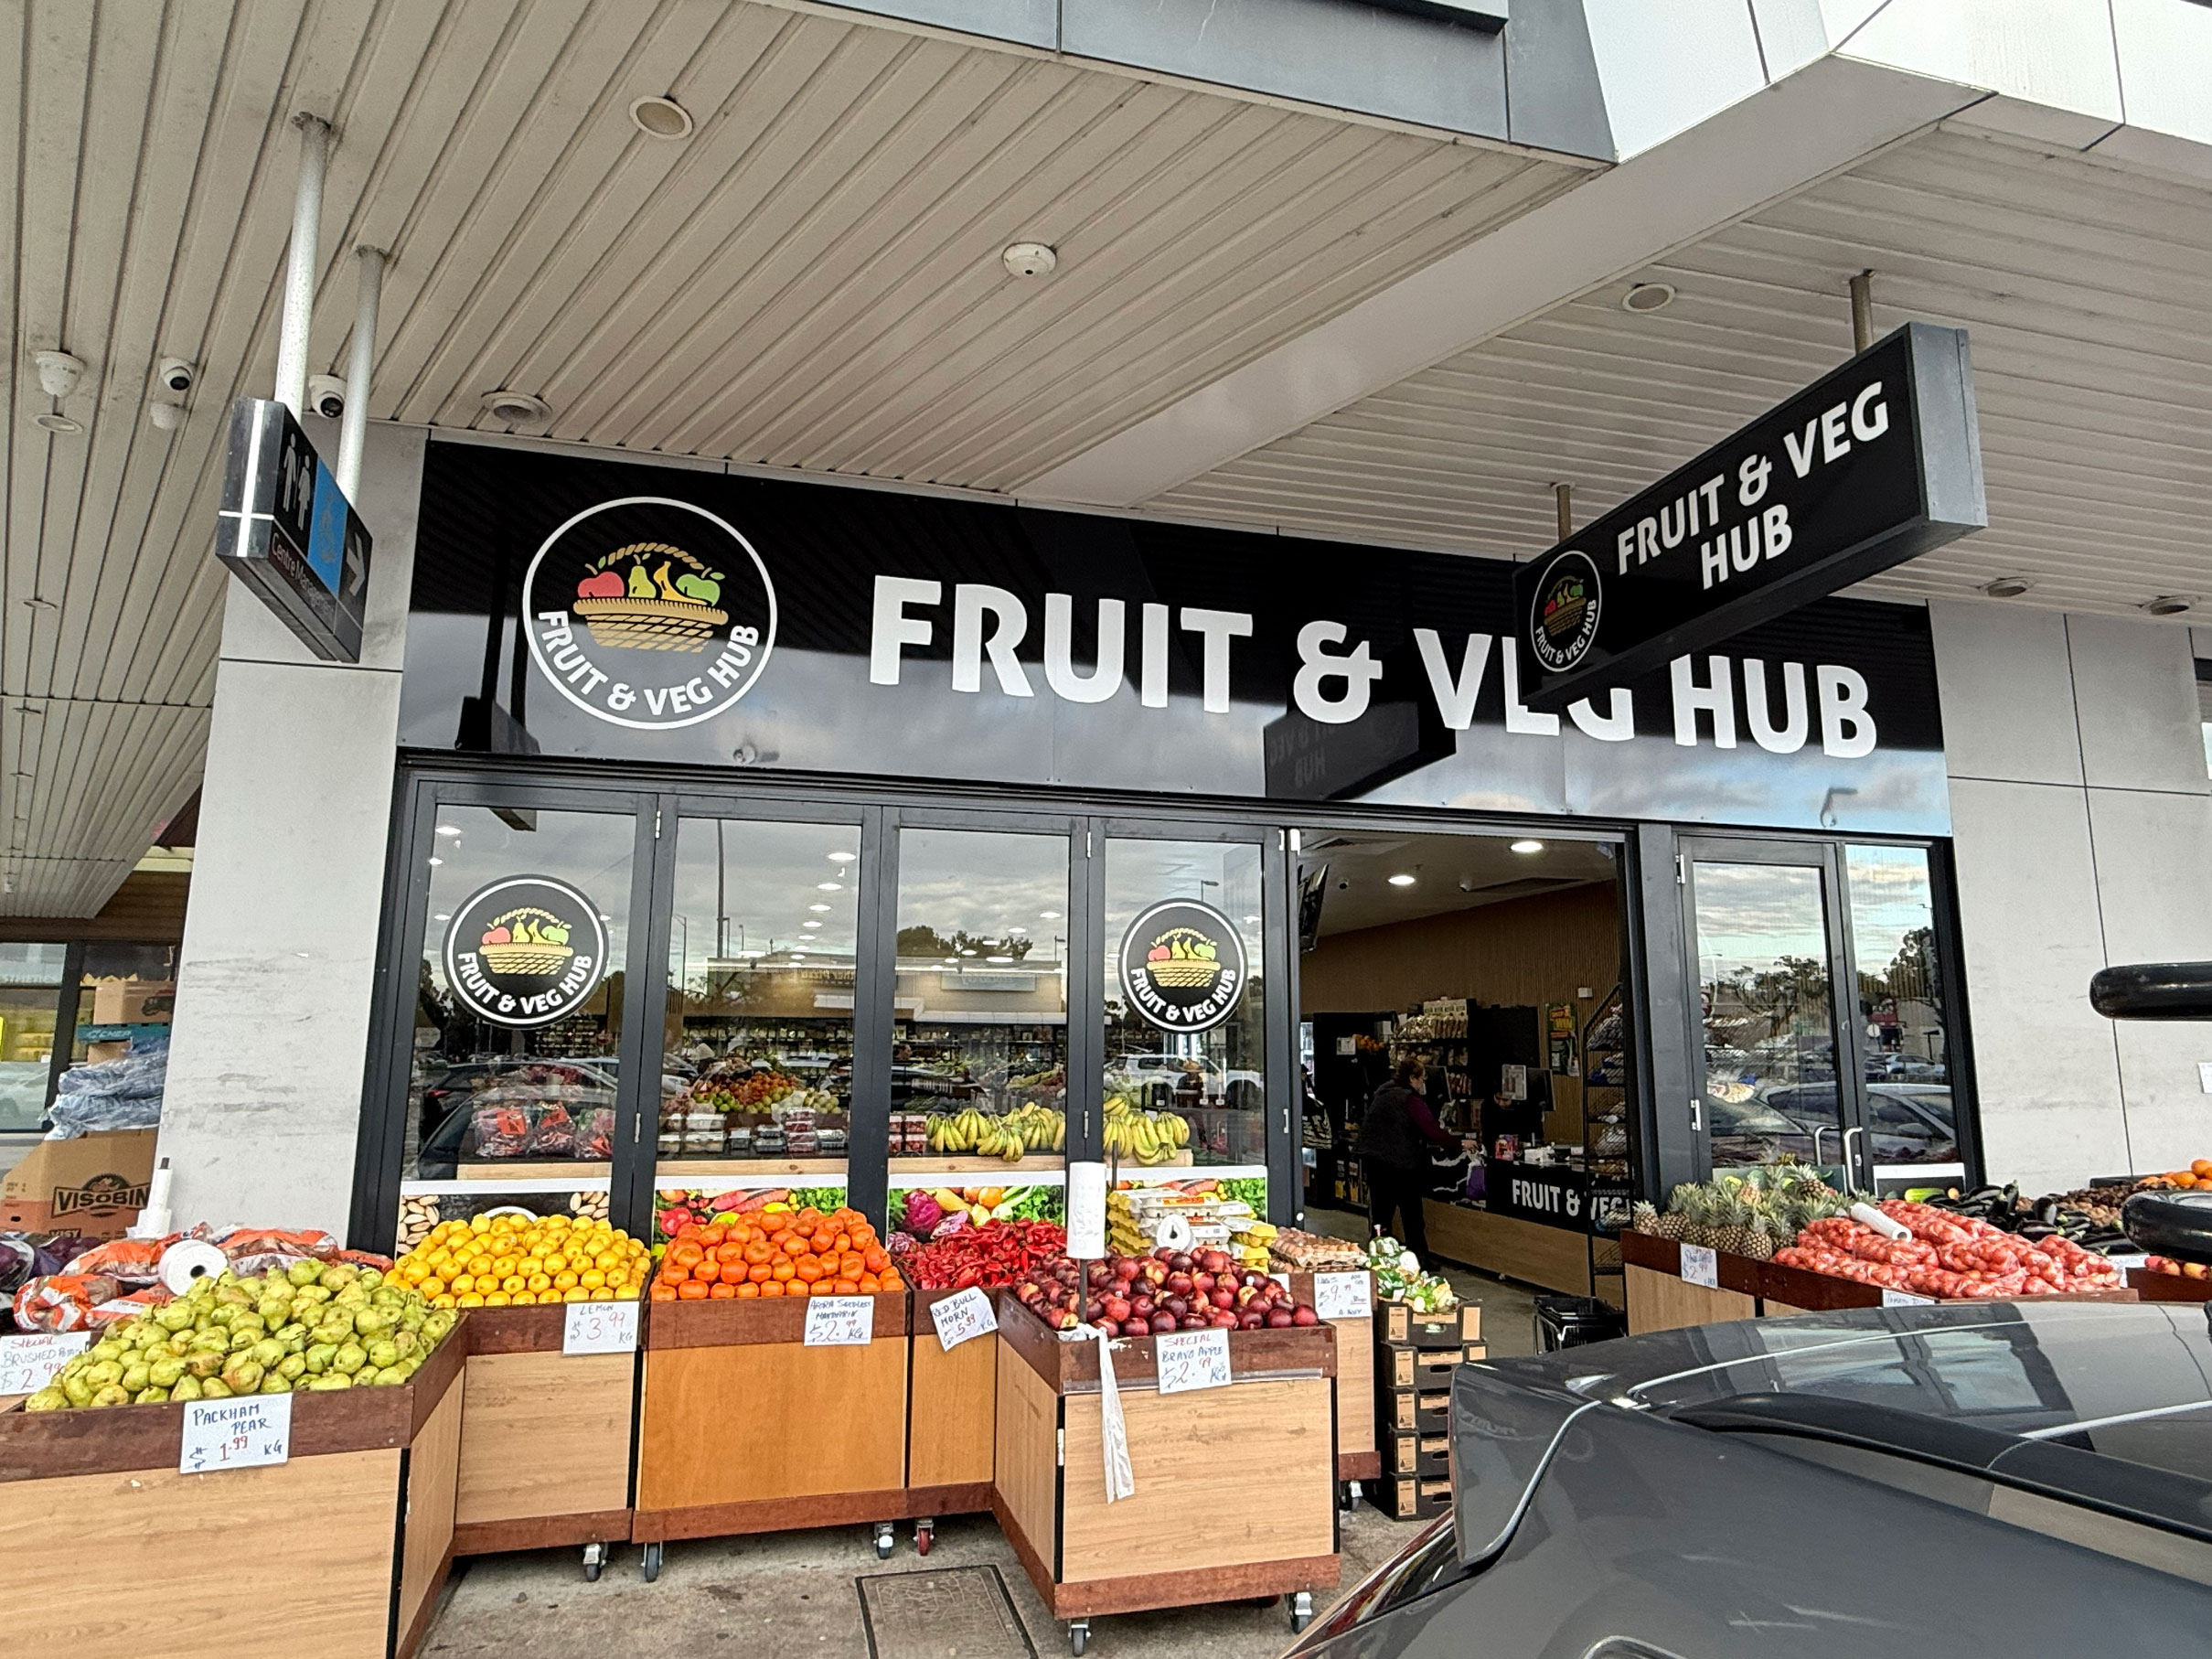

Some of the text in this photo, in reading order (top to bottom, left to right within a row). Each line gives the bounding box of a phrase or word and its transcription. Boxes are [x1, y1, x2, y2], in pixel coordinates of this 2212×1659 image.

[1617, 380, 1889, 575] FRUIT & VEG
[272, 532, 295, 578] Centre
[1700, 503, 1793, 591] HUB
[1535, 599, 1597, 664] FRUIT & VEG HUB
[538, 611, 759, 716] FRUIT & VEG HUB
[870, 574, 1253, 714] FRUIT
[1293, 620, 1383, 724] &
[1670, 654, 1877, 758] HUB
[458, 952, 593, 1014] FRUIT & VEG HUB
[1130, 968, 1235, 1022] FRUIT & VEG HUB
[59, 1187, 150, 1211] VISOBIN
[1512, 1179, 1560, 1213] FRUIT
[1565, 1189, 1581, 1217] &
[580, 1304, 614, 1316] LEMON
[951, 1293, 977, 1311] BULL
[940, 1307, 968, 1328] HORN
[618, 1332, 633, 1344] KG
[1164, 1333, 1212, 1347] SPECIAL
[1, 1349, 56, 1368] BRUSHED
[1162, 1345, 1223, 1363] BRAVO APPLE
[193, 1403, 260, 1427] PACKHAM
[230, 1418, 272, 1436] PEAR
[263, 1439, 283, 1456] KG
